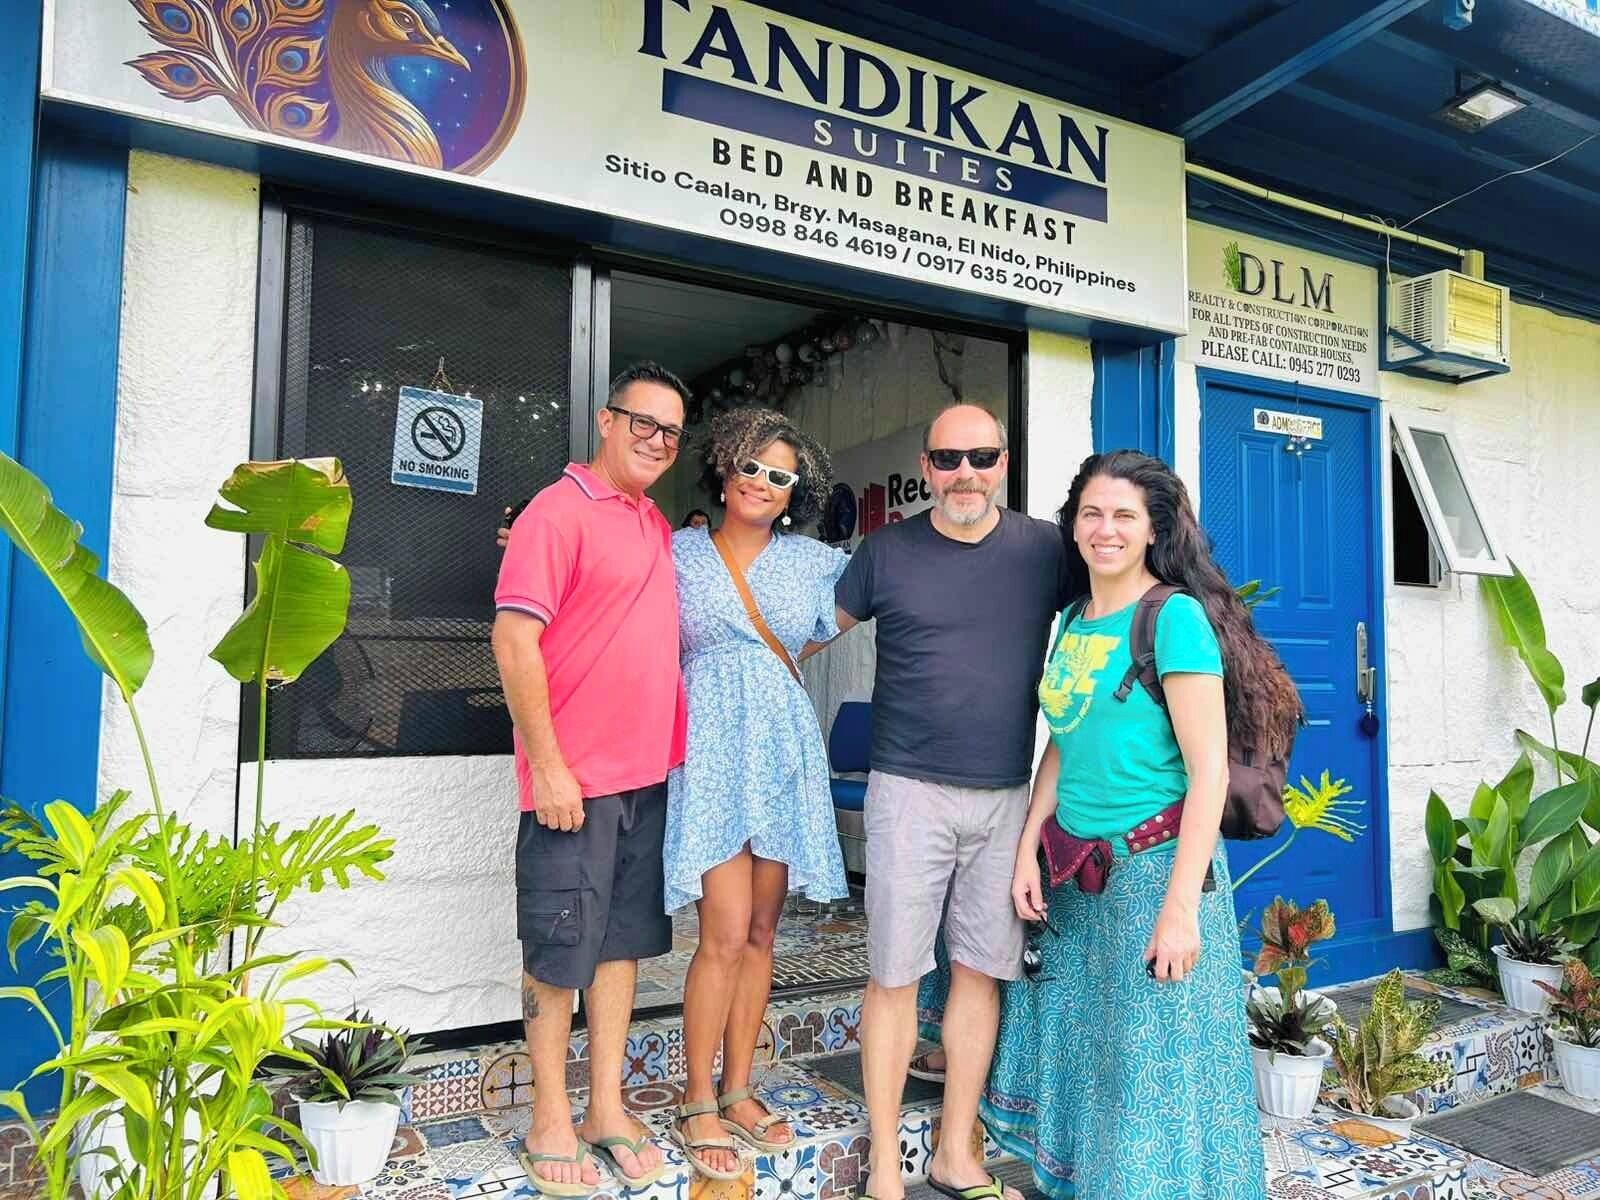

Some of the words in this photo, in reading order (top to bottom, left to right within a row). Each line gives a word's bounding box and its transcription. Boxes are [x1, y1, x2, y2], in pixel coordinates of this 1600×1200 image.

[638, 0, 1109, 183] TANDIKAN
[814, 119, 1013, 191] SUITES
[712, 137, 783, 177] BED
[806, 160, 873, 198] AND
[896, 180, 1076, 245] BREAKFAST
[605, 154, 666, 184] Sitio
[674, 172, 767, 210] Caalan,
[774, 194, 831, 224] Brgy.
[838, 208, 952, 251] Masagana,
[958, 237, 975, 255] El
[982, 243, 1030, 270] Nido,
[1036, 255, 1136, 293] Philippines
[719, 208, 786, 237] 0998
[794, 224, 839, 248] 846
[845, 236, 897, 260] 4619
[902, 247, 911, 263] /
[917, 251, 965, 275] 0917
[971, 264, 1008, 285] 635
[1013, 273, 1064, 297] 2007
[1238, 252, 1334, 313] DLM
[1188, 290, 1226, 308] REALTY
[1228, 299, 1235, 310] &
[1236, 301, 1307, 324] CONSTRUCTION
[1308, 316, 1369, 338] CORPORATION
[1192, 307, 1212, 322] FOR
[1213, 312, 1232, 326] ALL
[1233, 316, 1260, 332] TYPES
[1262, 322, 1274, 335] OF
[1275, 325, 1340, 348] CONSTRUCTION
[1341, 339, 1367, 353] NEEDS
[1208, 326, 1229, 340] AND
[1231, 329, 1268, 347] PRE-FAB
[1269, 337, 1318, 357] CONTAINER
[1201, 340, 1249, 363] PLEASE
[1252, 350, 1287, 370] CALL:
[1289, 356, 1314, 375] 0945
[1316, 361, 1334, 378] 277
[1337, 365, 1361, 383] 0293
[400, 460, 415, 472] NO
[418, 463, 469, 480] SMOKING
